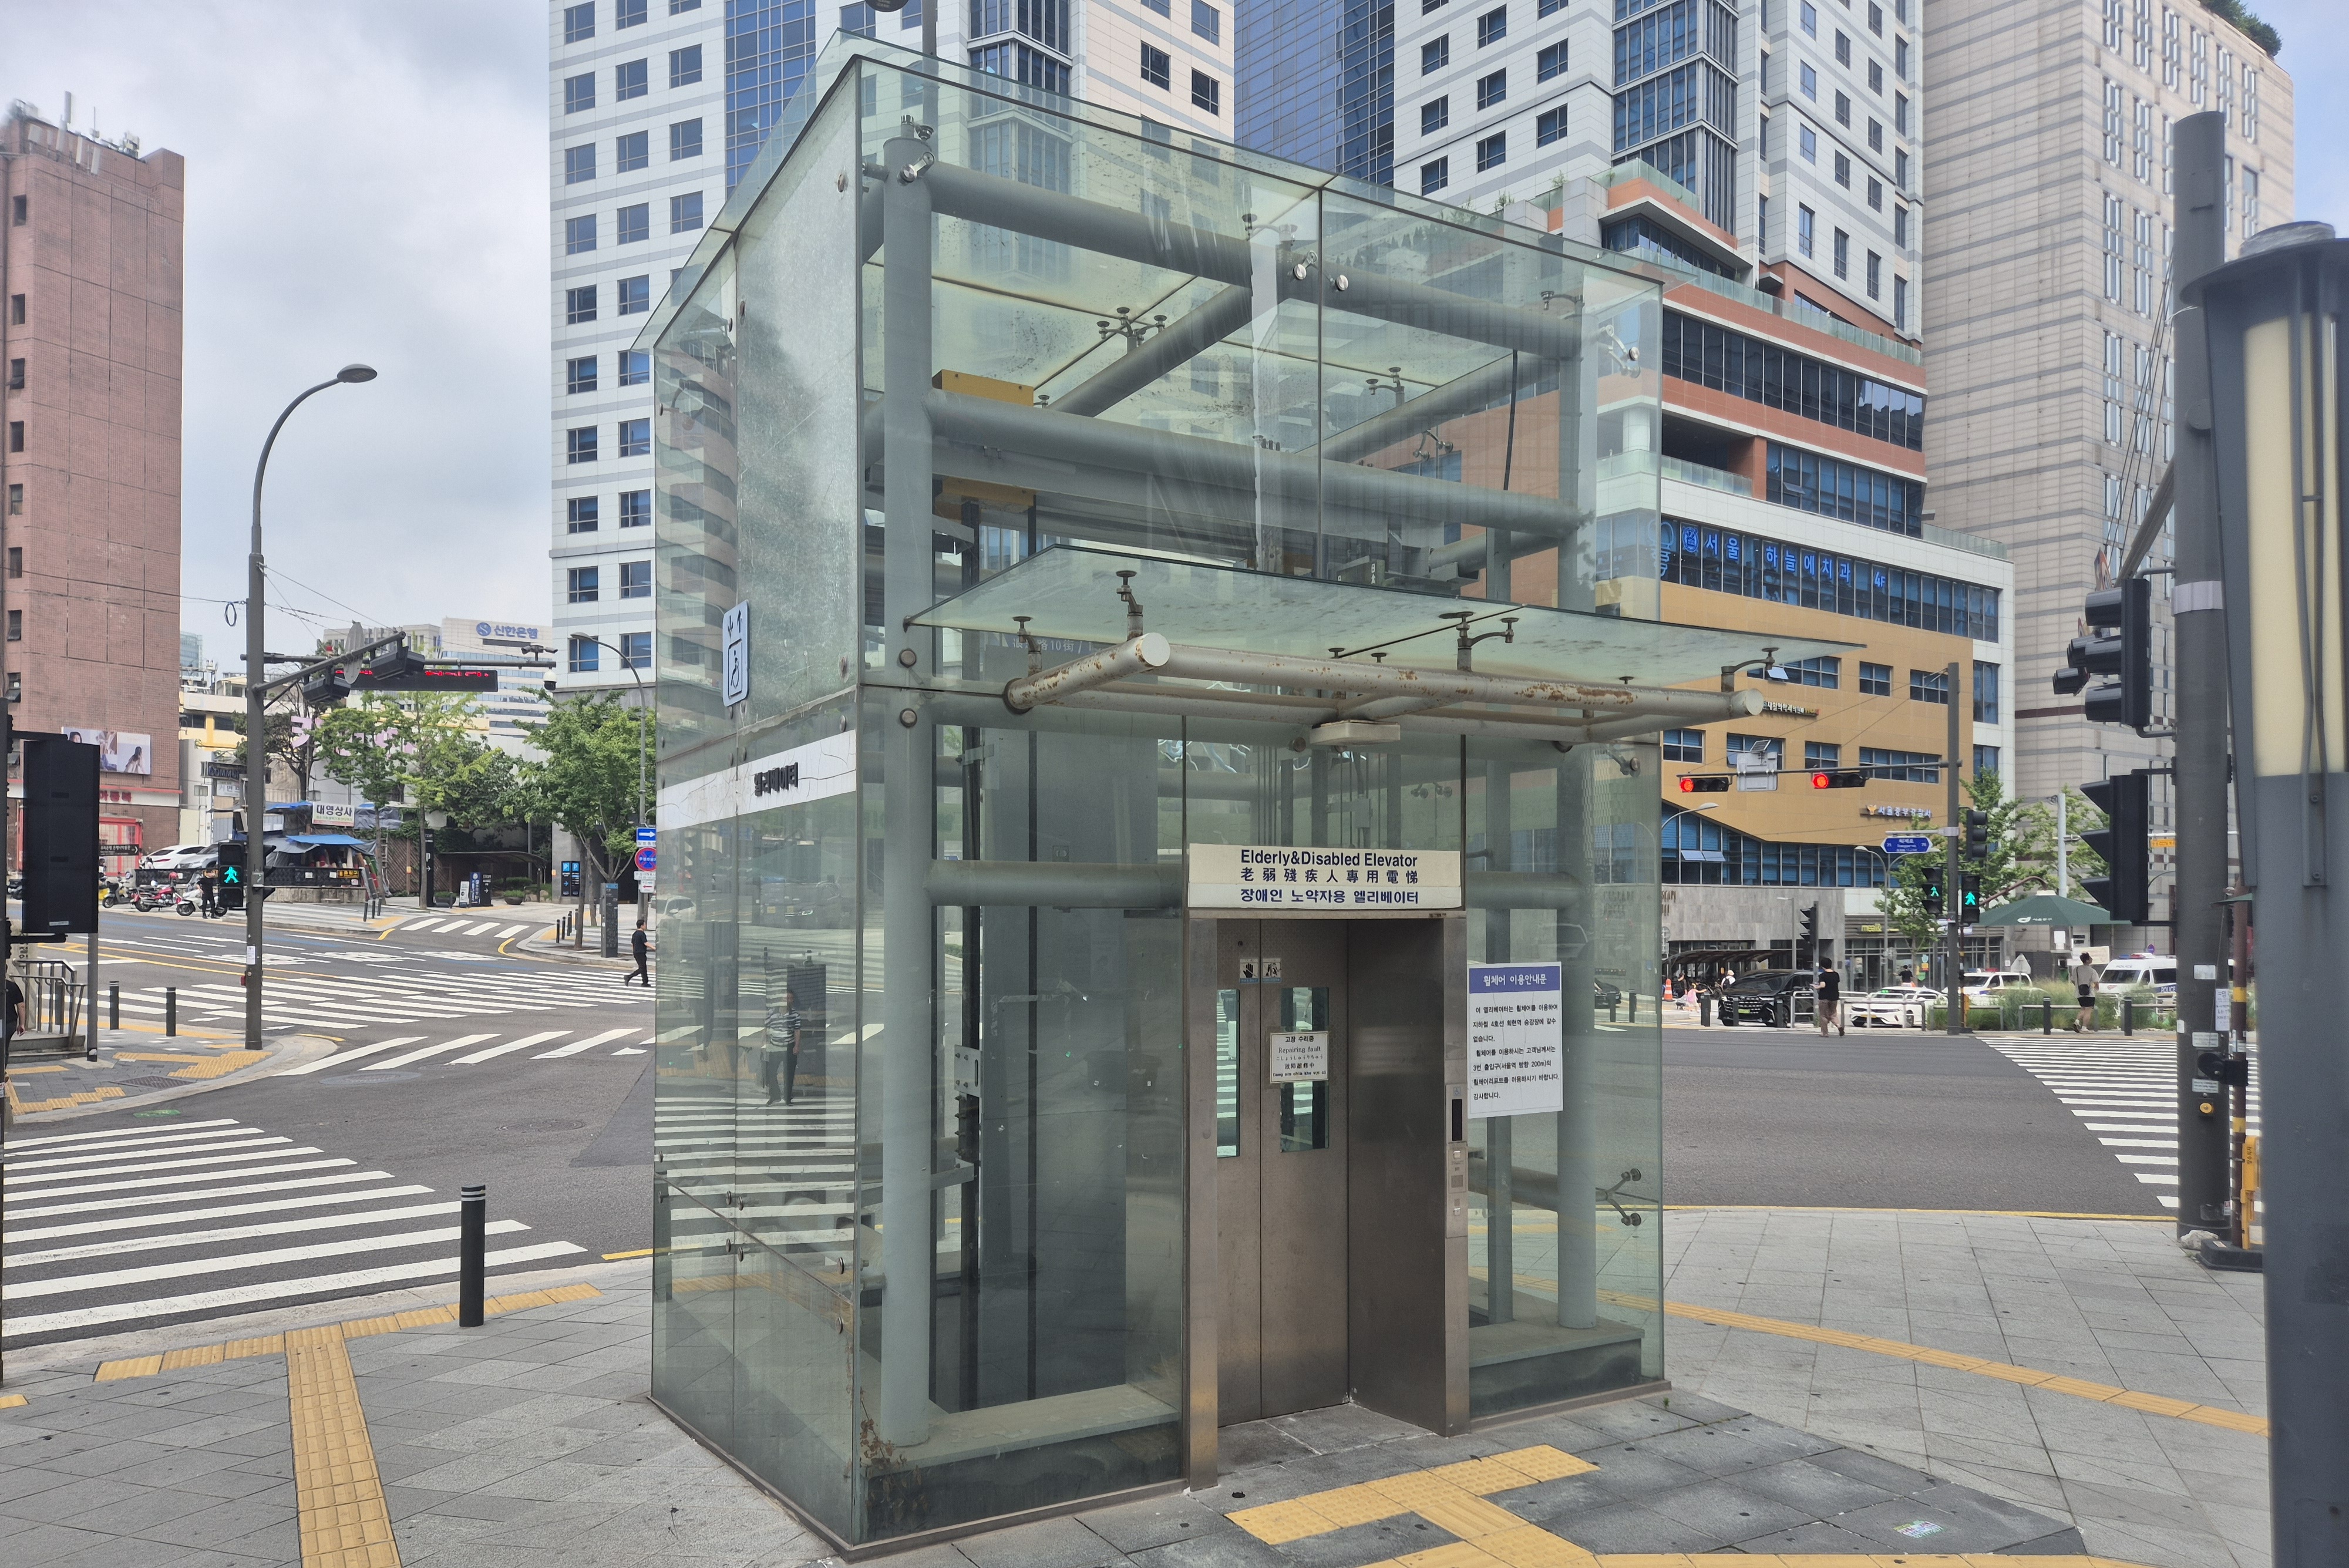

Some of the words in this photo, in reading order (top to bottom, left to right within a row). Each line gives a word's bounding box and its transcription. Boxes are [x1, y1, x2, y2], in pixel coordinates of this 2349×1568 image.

[1706, 533, 1739, 561] 서울
[1765, 545, 1851, 583] 하늘에치과
[1875, 570, 1886, 588] 4F
[494, 625, 538, 640] 신한은행
[754, 762, 798, 796] 엘리베이터
[317, 805, 352, 817] 대영상사
[1241, 849, 1359, 866] Elderly&Disabled
[1364, 853, 1418, 867] Elevator
[1240, 889, 1283, 903] 장애인
[1291, 890, 1345, 903] 노약자용
[1354, 890, 1419, 904] 엘리베이터
[1483, 975, 1505, 987] 휠체어
[1510, 974, 1547, 985] 이용안내문
[1484, 1062, 1516, 1071] 출입구(서울역
[1531, 1059, 1552, 1068] 200m)의
[1473, 1077, 1508, 1086] 휠체어리프트를
[1473, 1092, 1500, 1100] 감사합니다.
